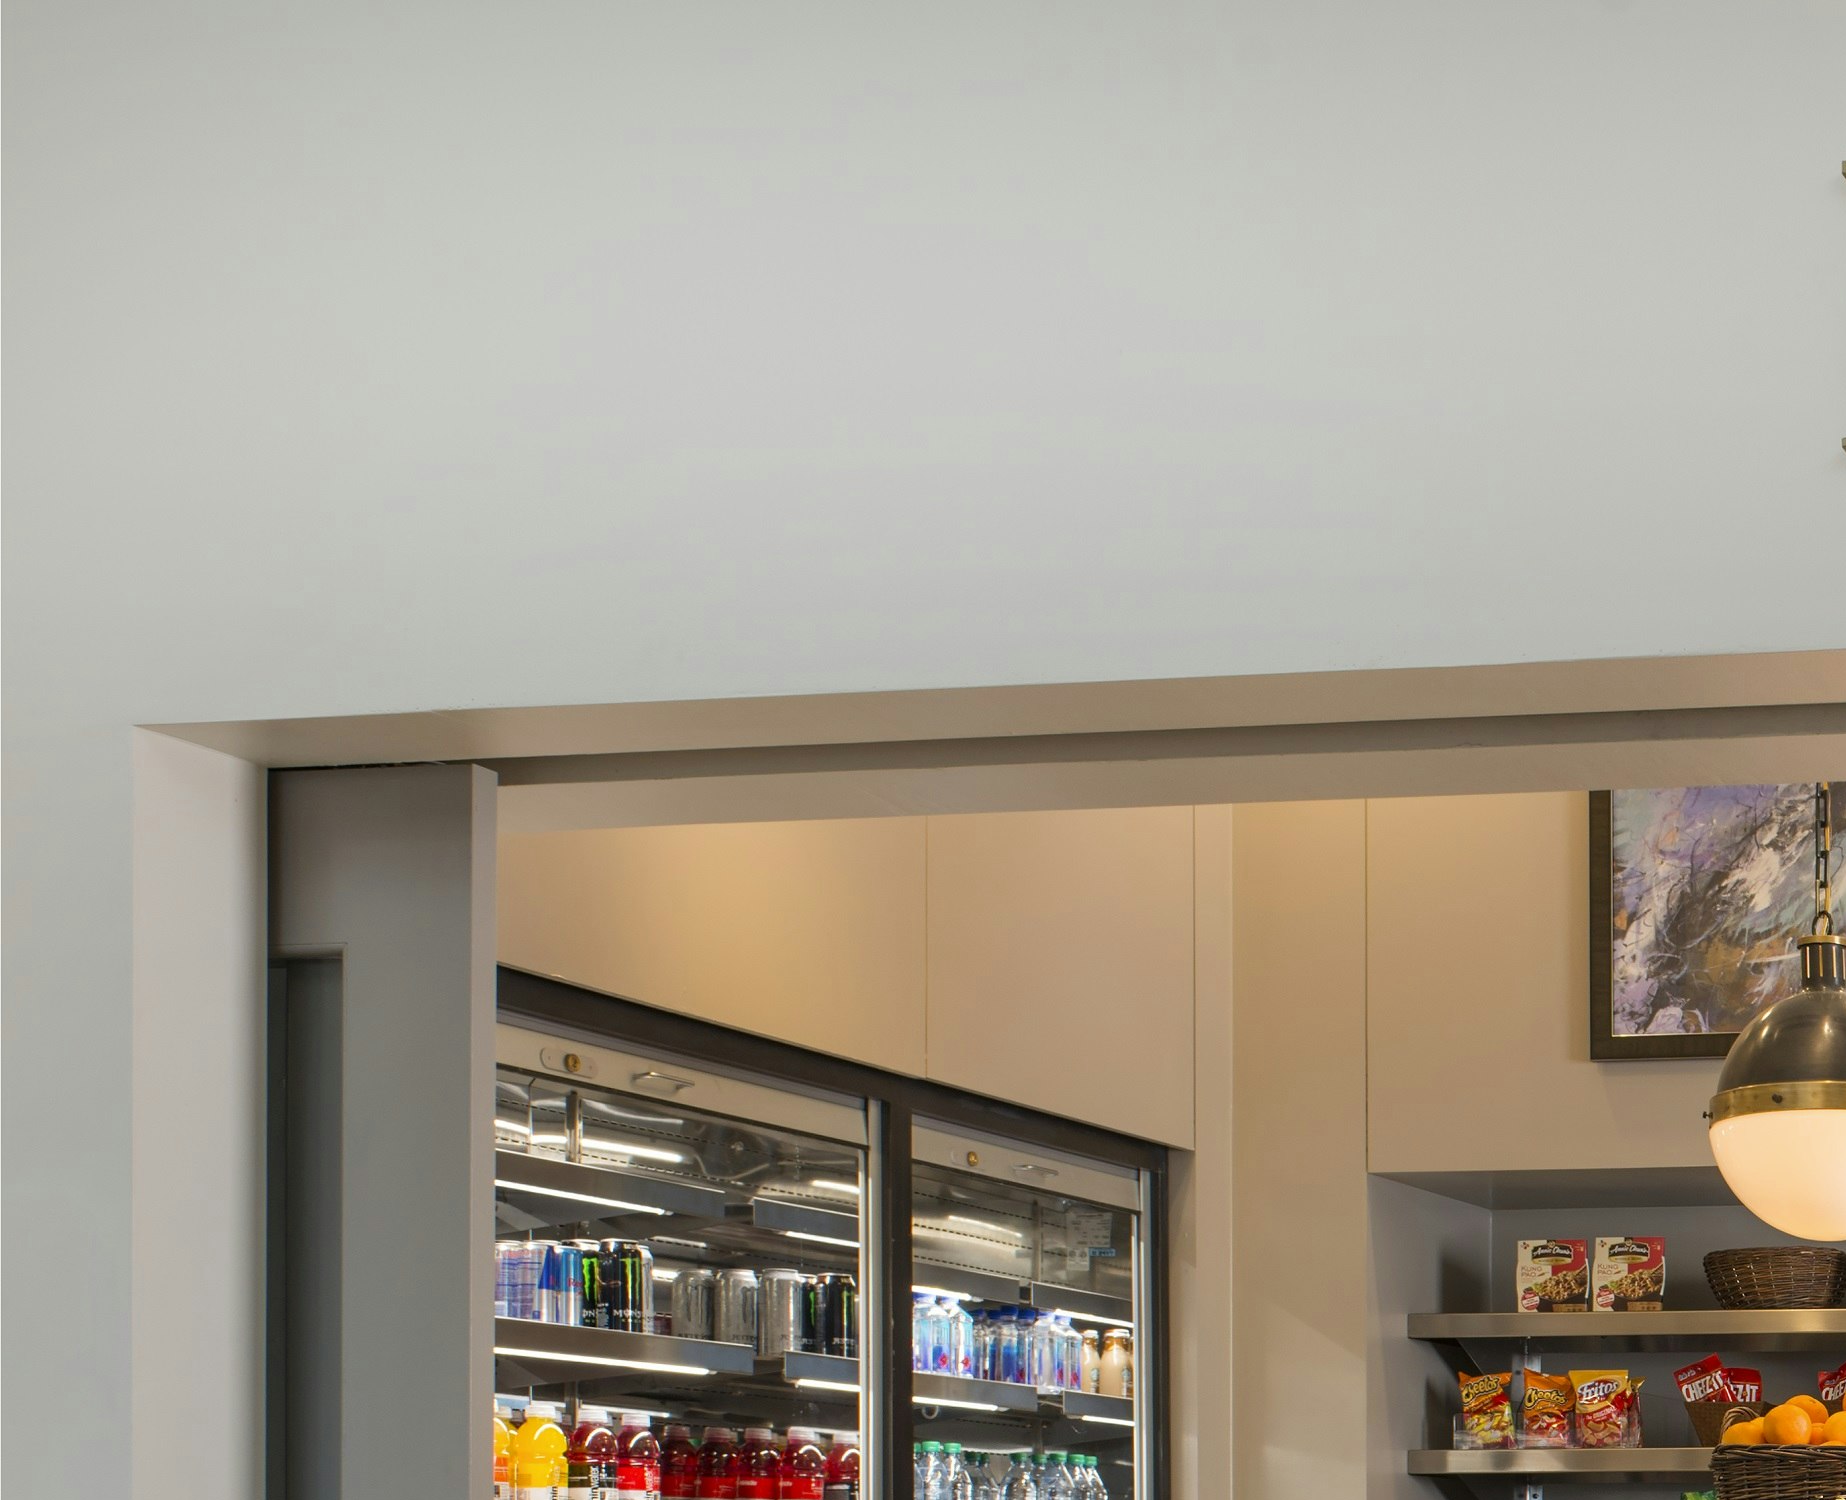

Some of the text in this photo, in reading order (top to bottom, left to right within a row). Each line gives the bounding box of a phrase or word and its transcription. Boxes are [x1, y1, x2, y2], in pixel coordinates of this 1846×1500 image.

[1462, 1376, 1498, 1400] Cheetos
[1524, 1388, 1566, 1409] Cheetos
[1578, 1379, 1620, 1402] Fritos
